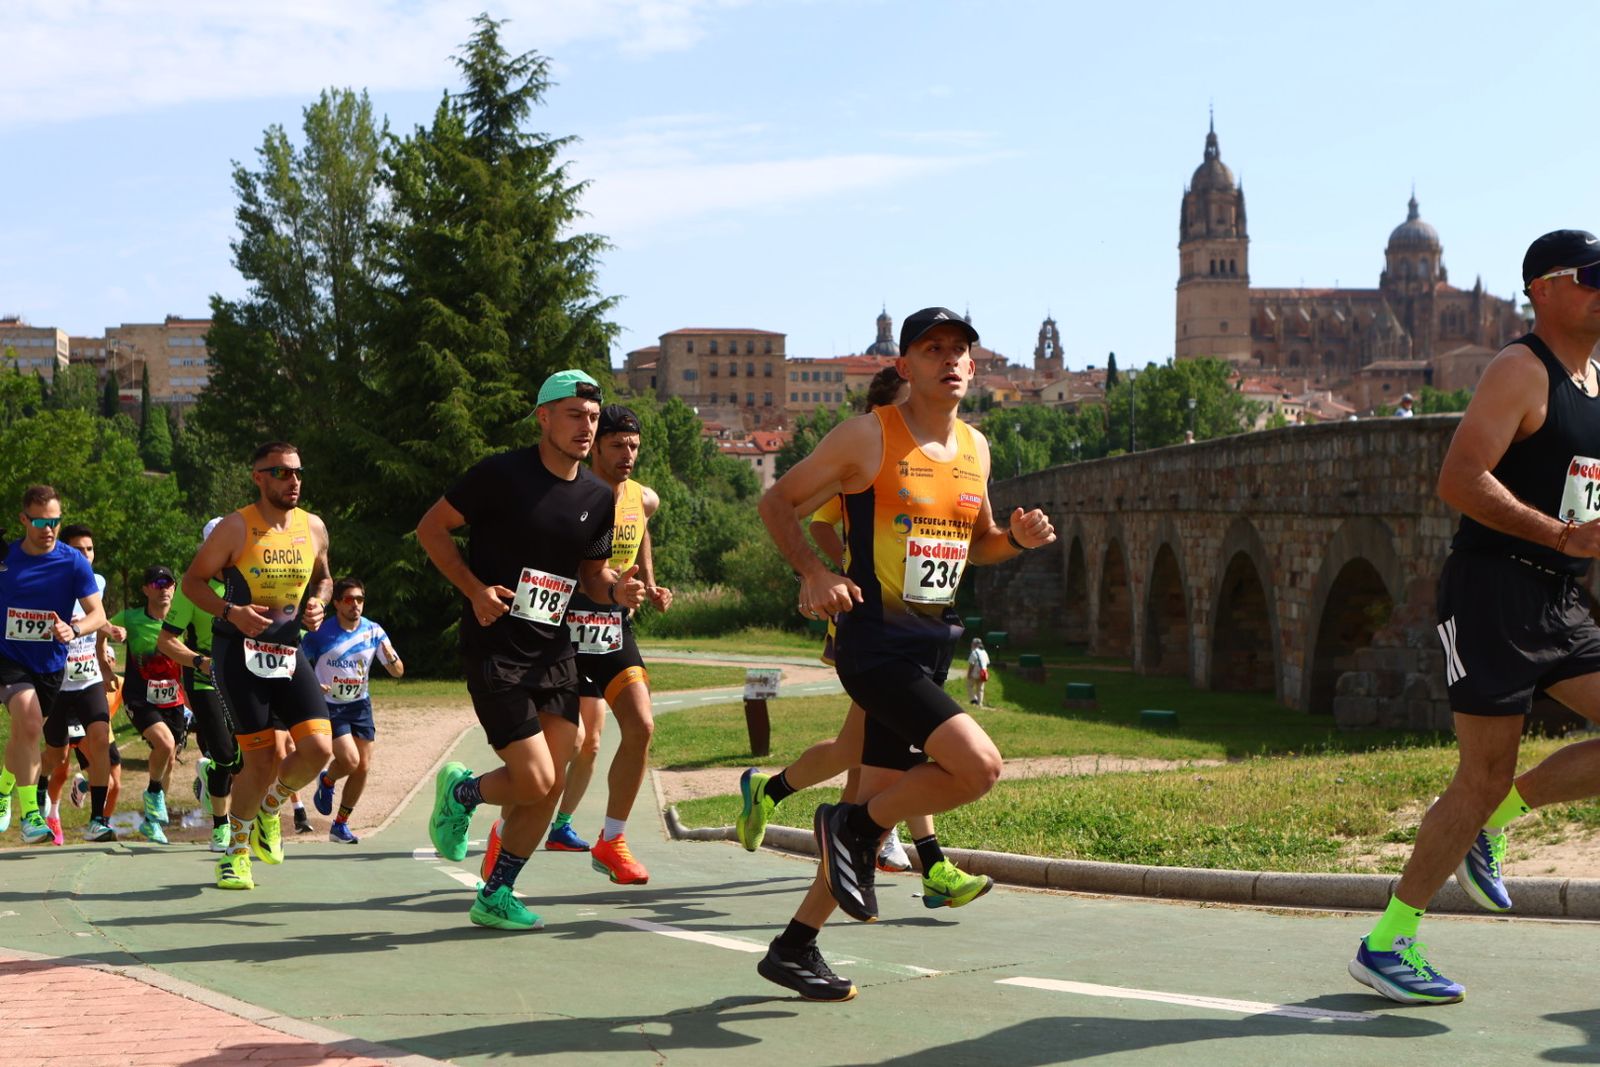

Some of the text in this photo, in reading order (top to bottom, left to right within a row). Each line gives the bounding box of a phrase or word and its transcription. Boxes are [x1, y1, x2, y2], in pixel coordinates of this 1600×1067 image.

[913, 516, 947, 526] ESCUELA
[263, 546, 303, 565] GARCÍA
[920, 559, 960, 588] 236
[528, 587, 561, 613] 198
[16, 619, 46, 634] 199
[577, 624, 613, 645] 174
[74, 661, 95, 675] 242
[255, 652, 288, 669] 104
[154, 687, 175, 698] 190
[339, 684, 360, 695] 197
